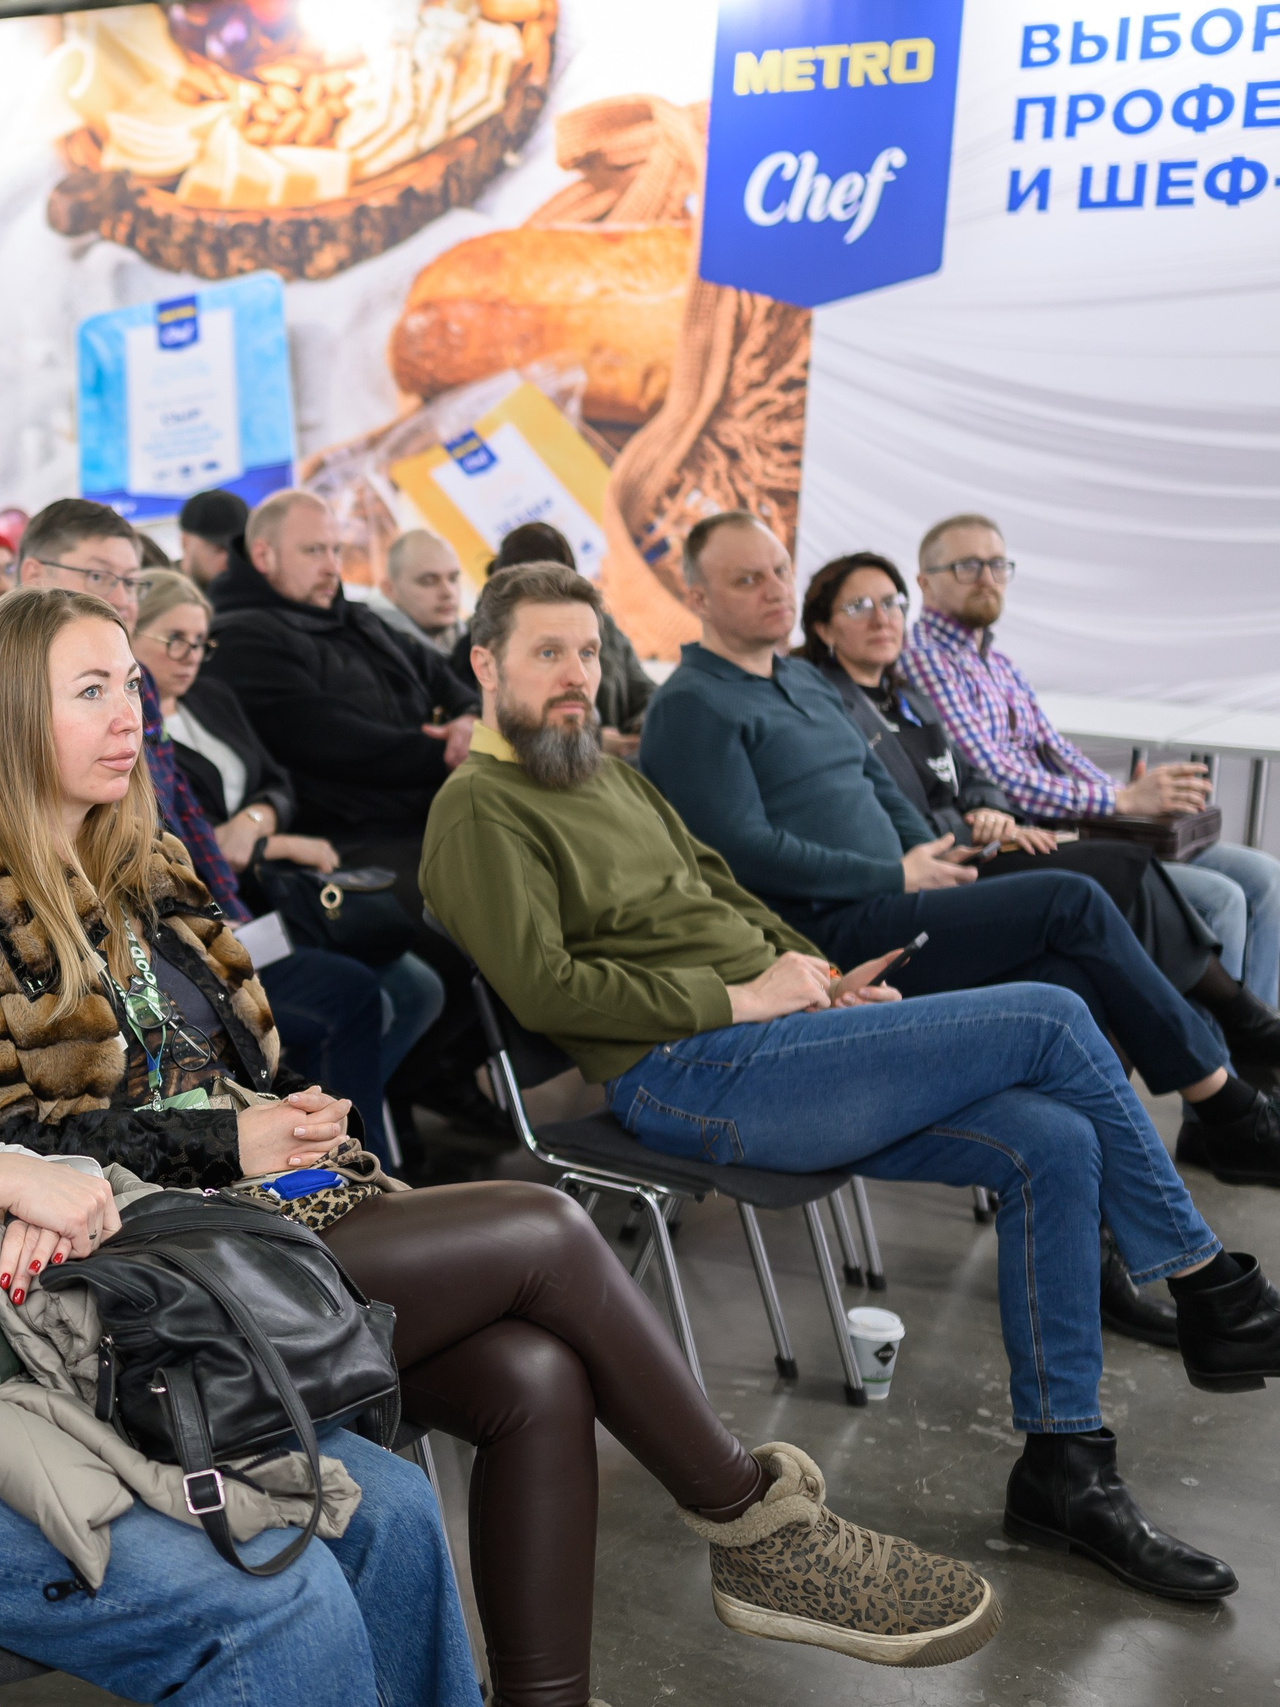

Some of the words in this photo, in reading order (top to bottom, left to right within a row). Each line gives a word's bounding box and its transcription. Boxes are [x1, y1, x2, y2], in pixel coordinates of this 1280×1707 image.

[733, 37, 935, 96] METRO
[1020, 4, 1280, 69] ВЫБОР
[1013, 80, 1280, 142] ПРОФЕ
[744, 147, 907, 245] Chef
[1007, 168, 1051, 213] И
[1078, 156, 1280, 210] ШЕФ
